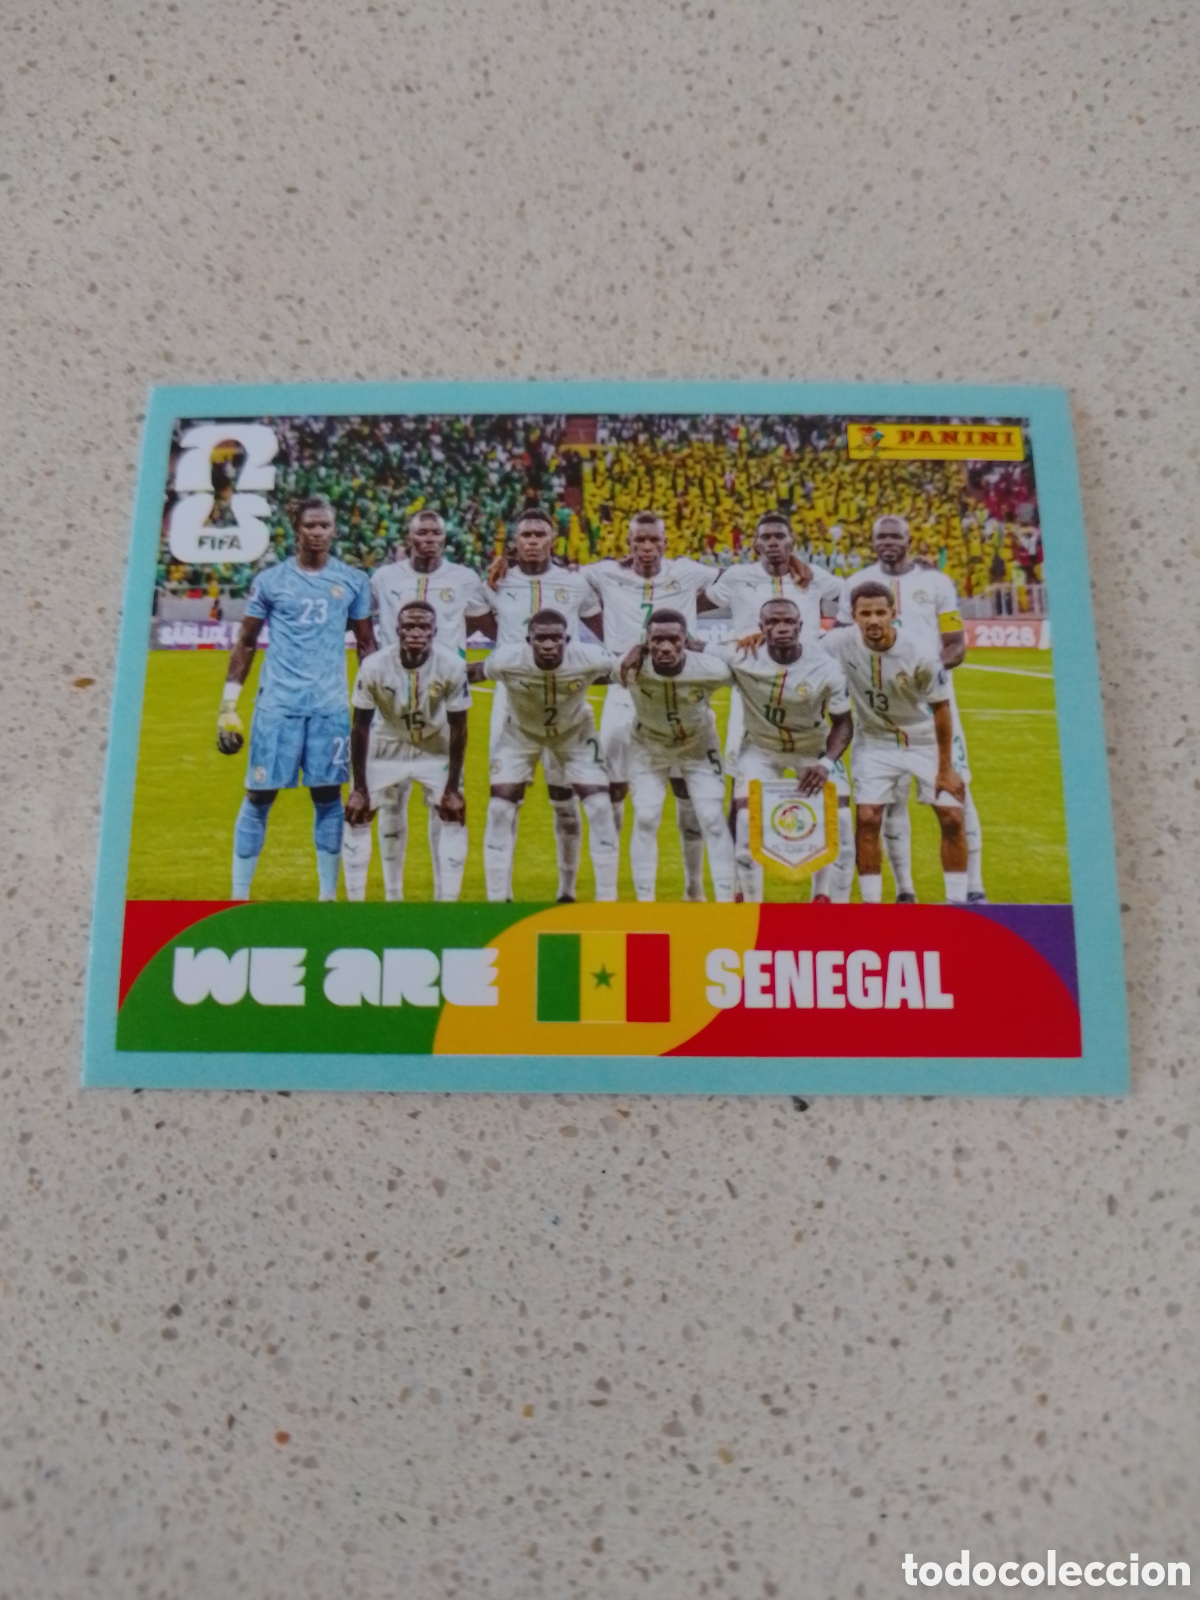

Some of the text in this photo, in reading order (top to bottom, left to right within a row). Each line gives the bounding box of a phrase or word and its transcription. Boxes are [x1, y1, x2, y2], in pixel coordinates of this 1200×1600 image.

[897, 429, 1015, 446] PANINI
[198, 535, 242, 550] FIFA
[299, 598, 328, 625] 23
[640, 603, 653, 629] 7
[975, 625, 1035, 647] 2026
[865, 690, 889, 712] 13
[401, 711, 426, 731] 15
[544, 707, 557, 727] 2
[667, 711, 680, 725] 5
[763, 704, 786, 725] 10
[586, 738, 603, 763] 2
[707, 749, 722, 775] 5
[172, 947, 954, 1009] WE ARE SENEGAL
